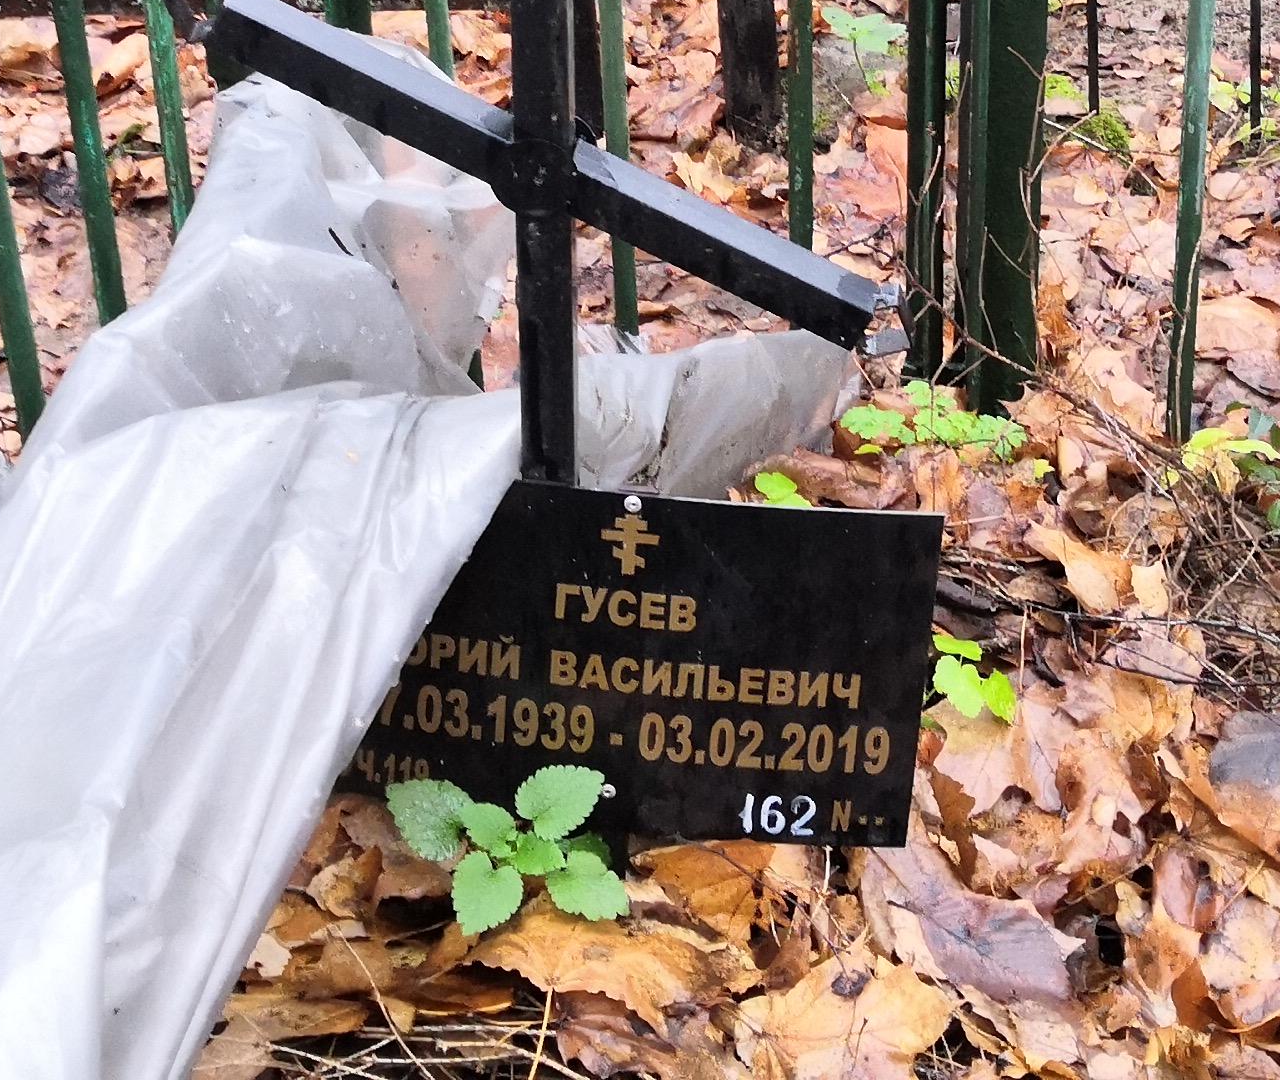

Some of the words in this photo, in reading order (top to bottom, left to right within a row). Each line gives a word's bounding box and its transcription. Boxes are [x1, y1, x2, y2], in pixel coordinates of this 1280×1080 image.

[555, 583, 697, 632] ГУСЕВ
[549, 649, 862, 709] ВАСИЛЬЕВИЧ
[380, 681, 595, 754] 7.03.1939
[609, 732, 623, 746] -
[638, 712, 890, 774] 03.02.2019
[738, 792, 817, 837] 162
